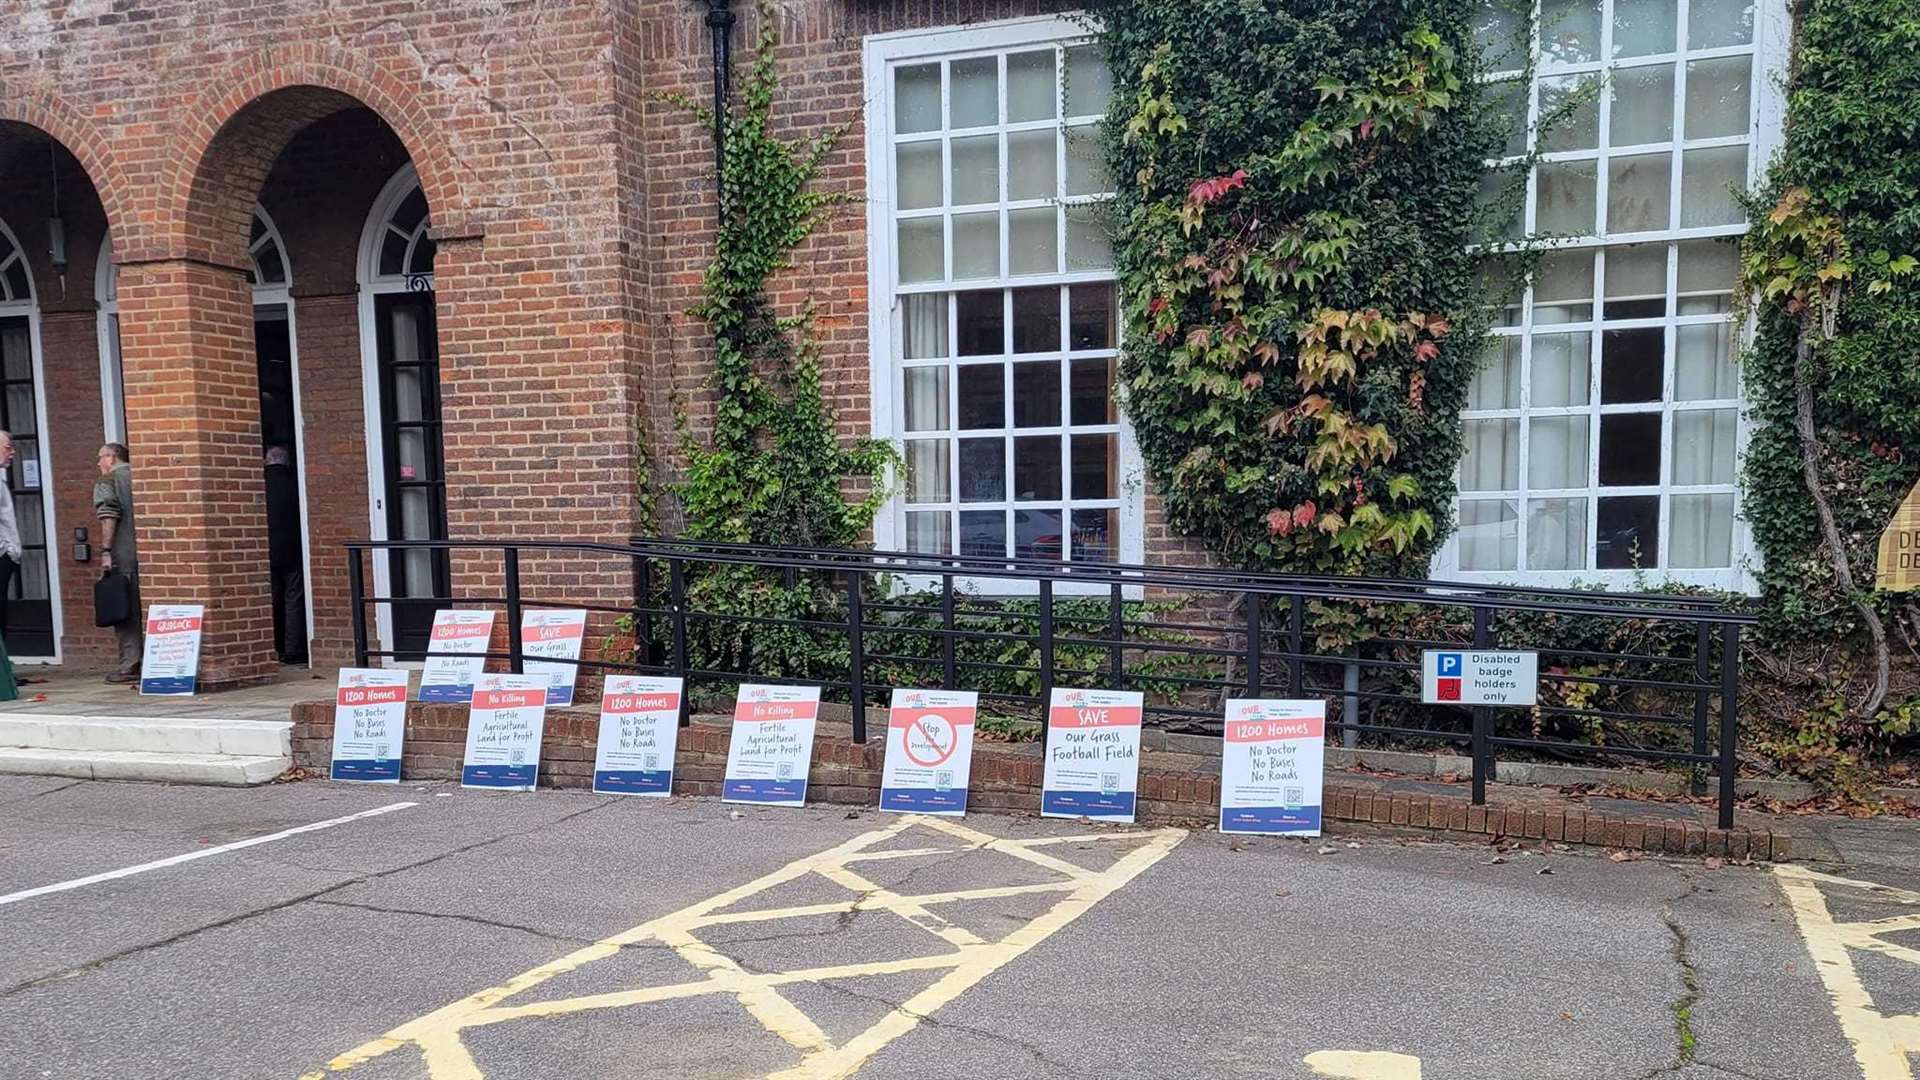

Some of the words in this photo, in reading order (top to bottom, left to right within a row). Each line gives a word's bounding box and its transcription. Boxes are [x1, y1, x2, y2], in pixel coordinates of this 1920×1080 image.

[538, 627, 562, 639] SAVE
[1443, 656, 1456, 672] P
[1472, 654, 1520, 664] Disabled
[1479, 667, 1513, 678] badge
[1474, 680, 1517, 689] holders
[345, 690, 365, 703] 1200
[367, 689, 396, 701] Homes
[488, 694, 499, 705] No
[502, 693, 526, 706] Killing
[1483, 692, 1507, 702] only
[611, 699, 632, 710] 1200
[635, 697, 668, 709] Homes
[353, 709, 363, 719] No
[365, 706, 387, 717] Doctor
[494, 711, 519, 721] Fertile
[753, 706, 765, 718] No
[767, 705, 795, 718] Killing
[1078, 709, 1110, 726] SAVE
[355, 719, 365, 728] No
[483, 720, 529, 734] Agricultural
[620, 716, 630, 727] No
[633, 715, 657, 726] Doctor
[621, 727, 632, 738] No
[635, 727, 655, 738] Buses
[760, 722, 786, 734] Fertile
[922, 721, 940, 737] Stop
[1236, 725, 1263, 739] 1200
[1268, 723, 1309, 737] Homes
[353, 730, 363, 740] No
[477, 734, 496, 743] Land
[500, 733, 510, 745] for
[513, 731, 533, 744] Profit
[747, 734, 797, 748] Agricultural
[1090, 728, 1120, 743] Grass
[620, 739, 630, 750] No
[634, 737, 656, 748] Roads
[740, 747, 761, 756] Land
[764, 747, 777, 759] for
[780, 744, 802, 757] Profit
[1053, 745, 1100, 763] Football
[1106, 744, 1134, 761] Field
[1249, 745, 1263, 758] No
[1266, 744, 1297, 755] Doctor
[1252, 758, 1265, 770] No
[1270, 757, 1296, 769] Buses
[1251, 771, 1264, 783] No
[1268, 768, 1298, 781] Roads
